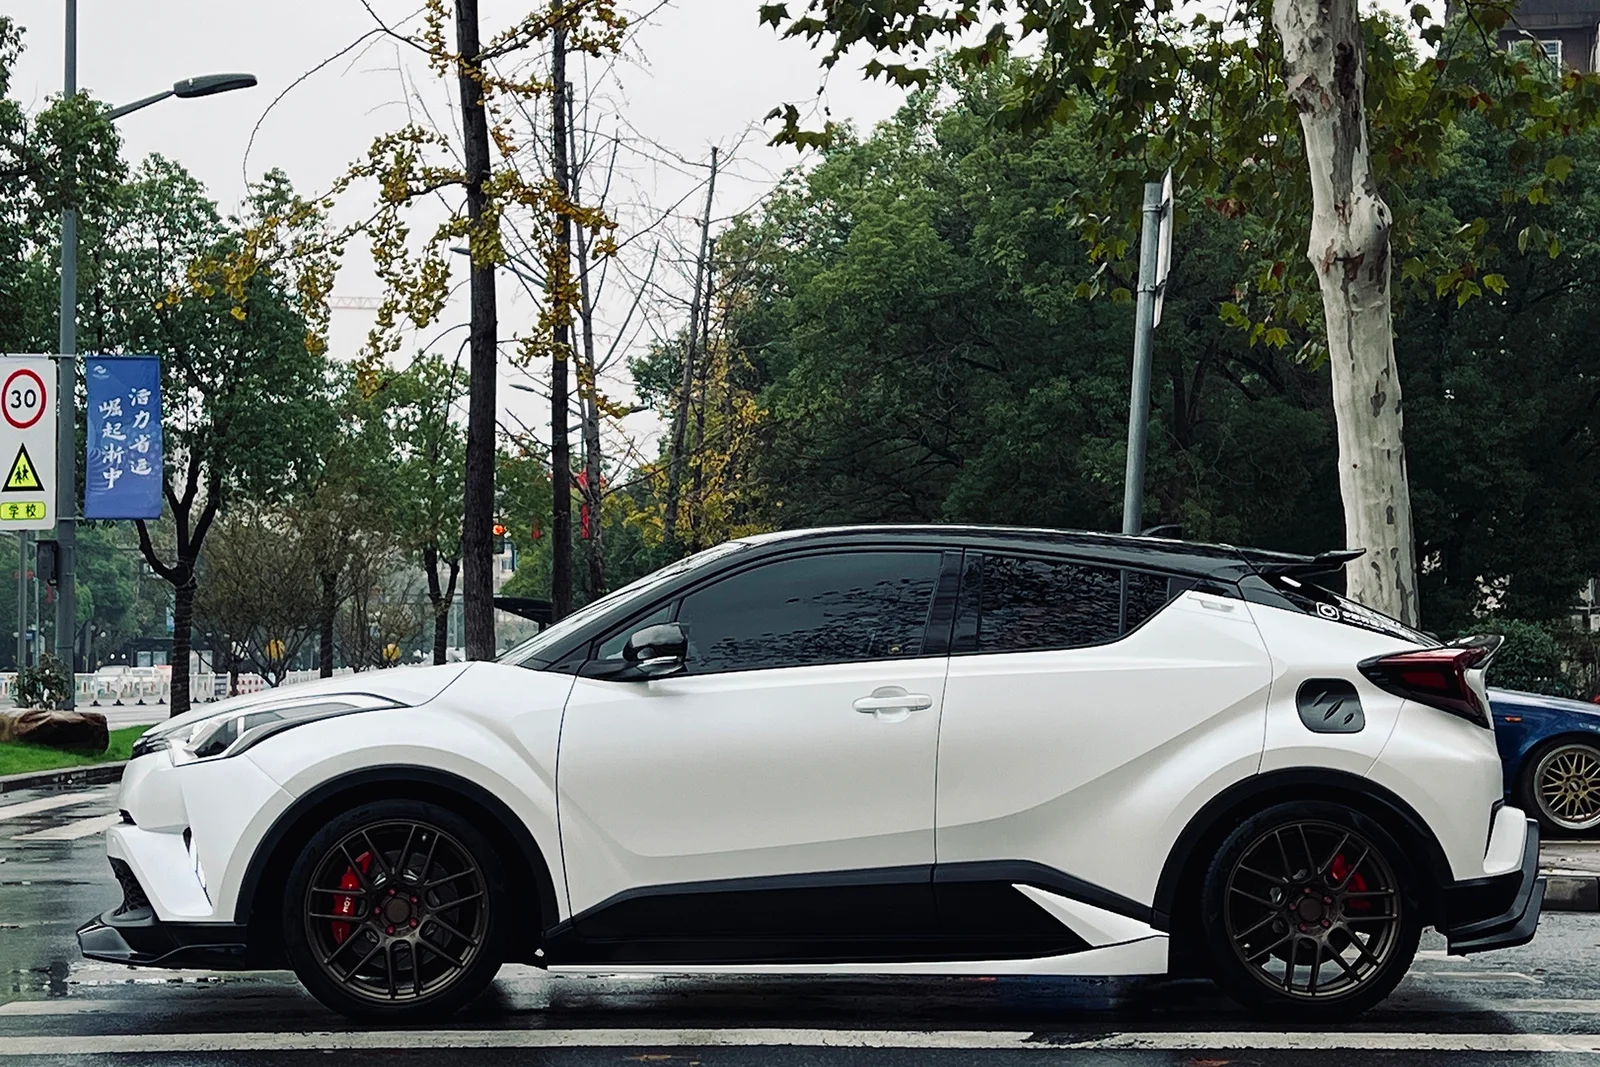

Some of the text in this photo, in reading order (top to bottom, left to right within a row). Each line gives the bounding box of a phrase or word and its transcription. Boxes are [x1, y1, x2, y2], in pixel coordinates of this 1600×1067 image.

[10, 389, 37, 409] 30
[98, 398, 127, 489] 崛起浙中
[128, 388, 152, 475] 活力省运
[8, 503, 37, 519] 学校
